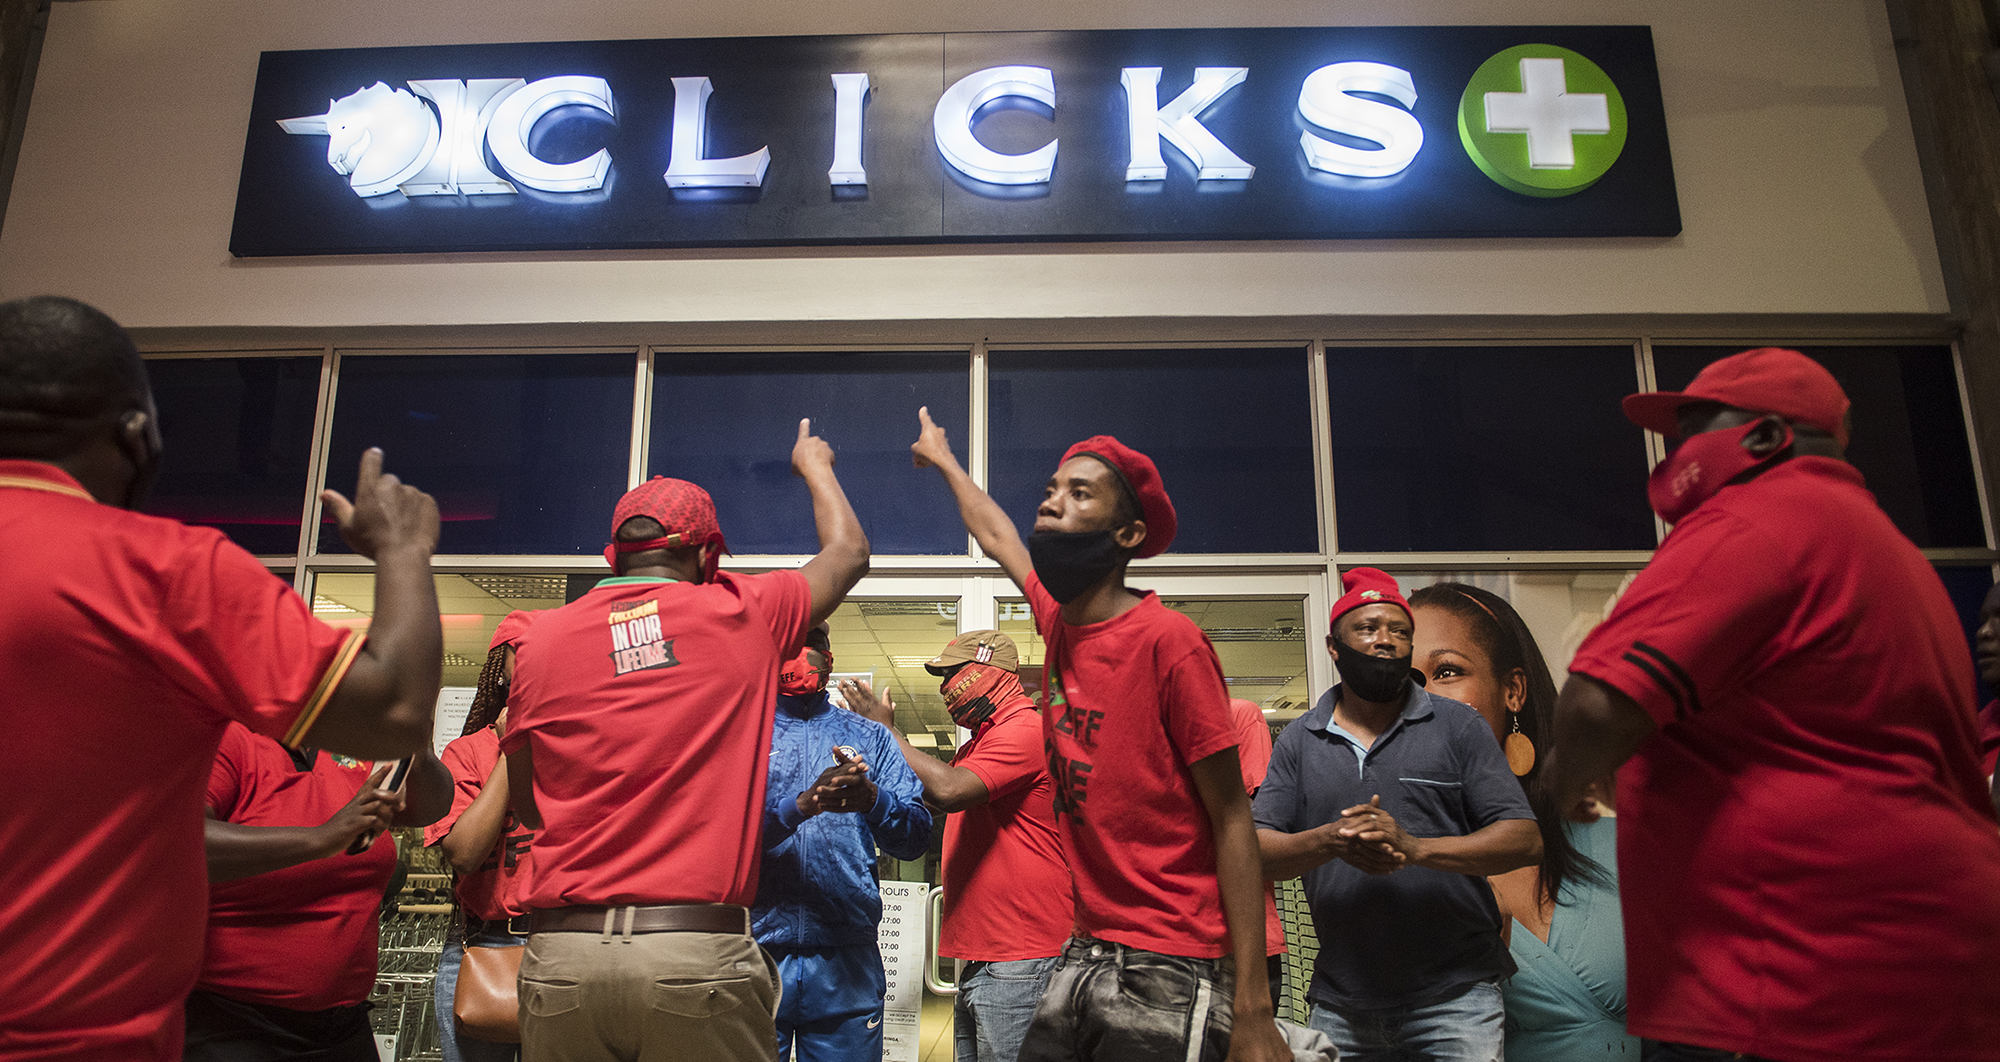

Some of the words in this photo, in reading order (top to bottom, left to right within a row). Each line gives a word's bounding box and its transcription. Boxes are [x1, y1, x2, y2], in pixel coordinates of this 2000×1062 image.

[486, 61, 1424, 192] CLICKS
[1672, 462, 1700, 497] EFF
[610, 622, 631, 651] IN
[628, 614, 663, 647] OUR
[780, 671, 795, 683] EFF
[883, 904, 902, 912] 17:00
